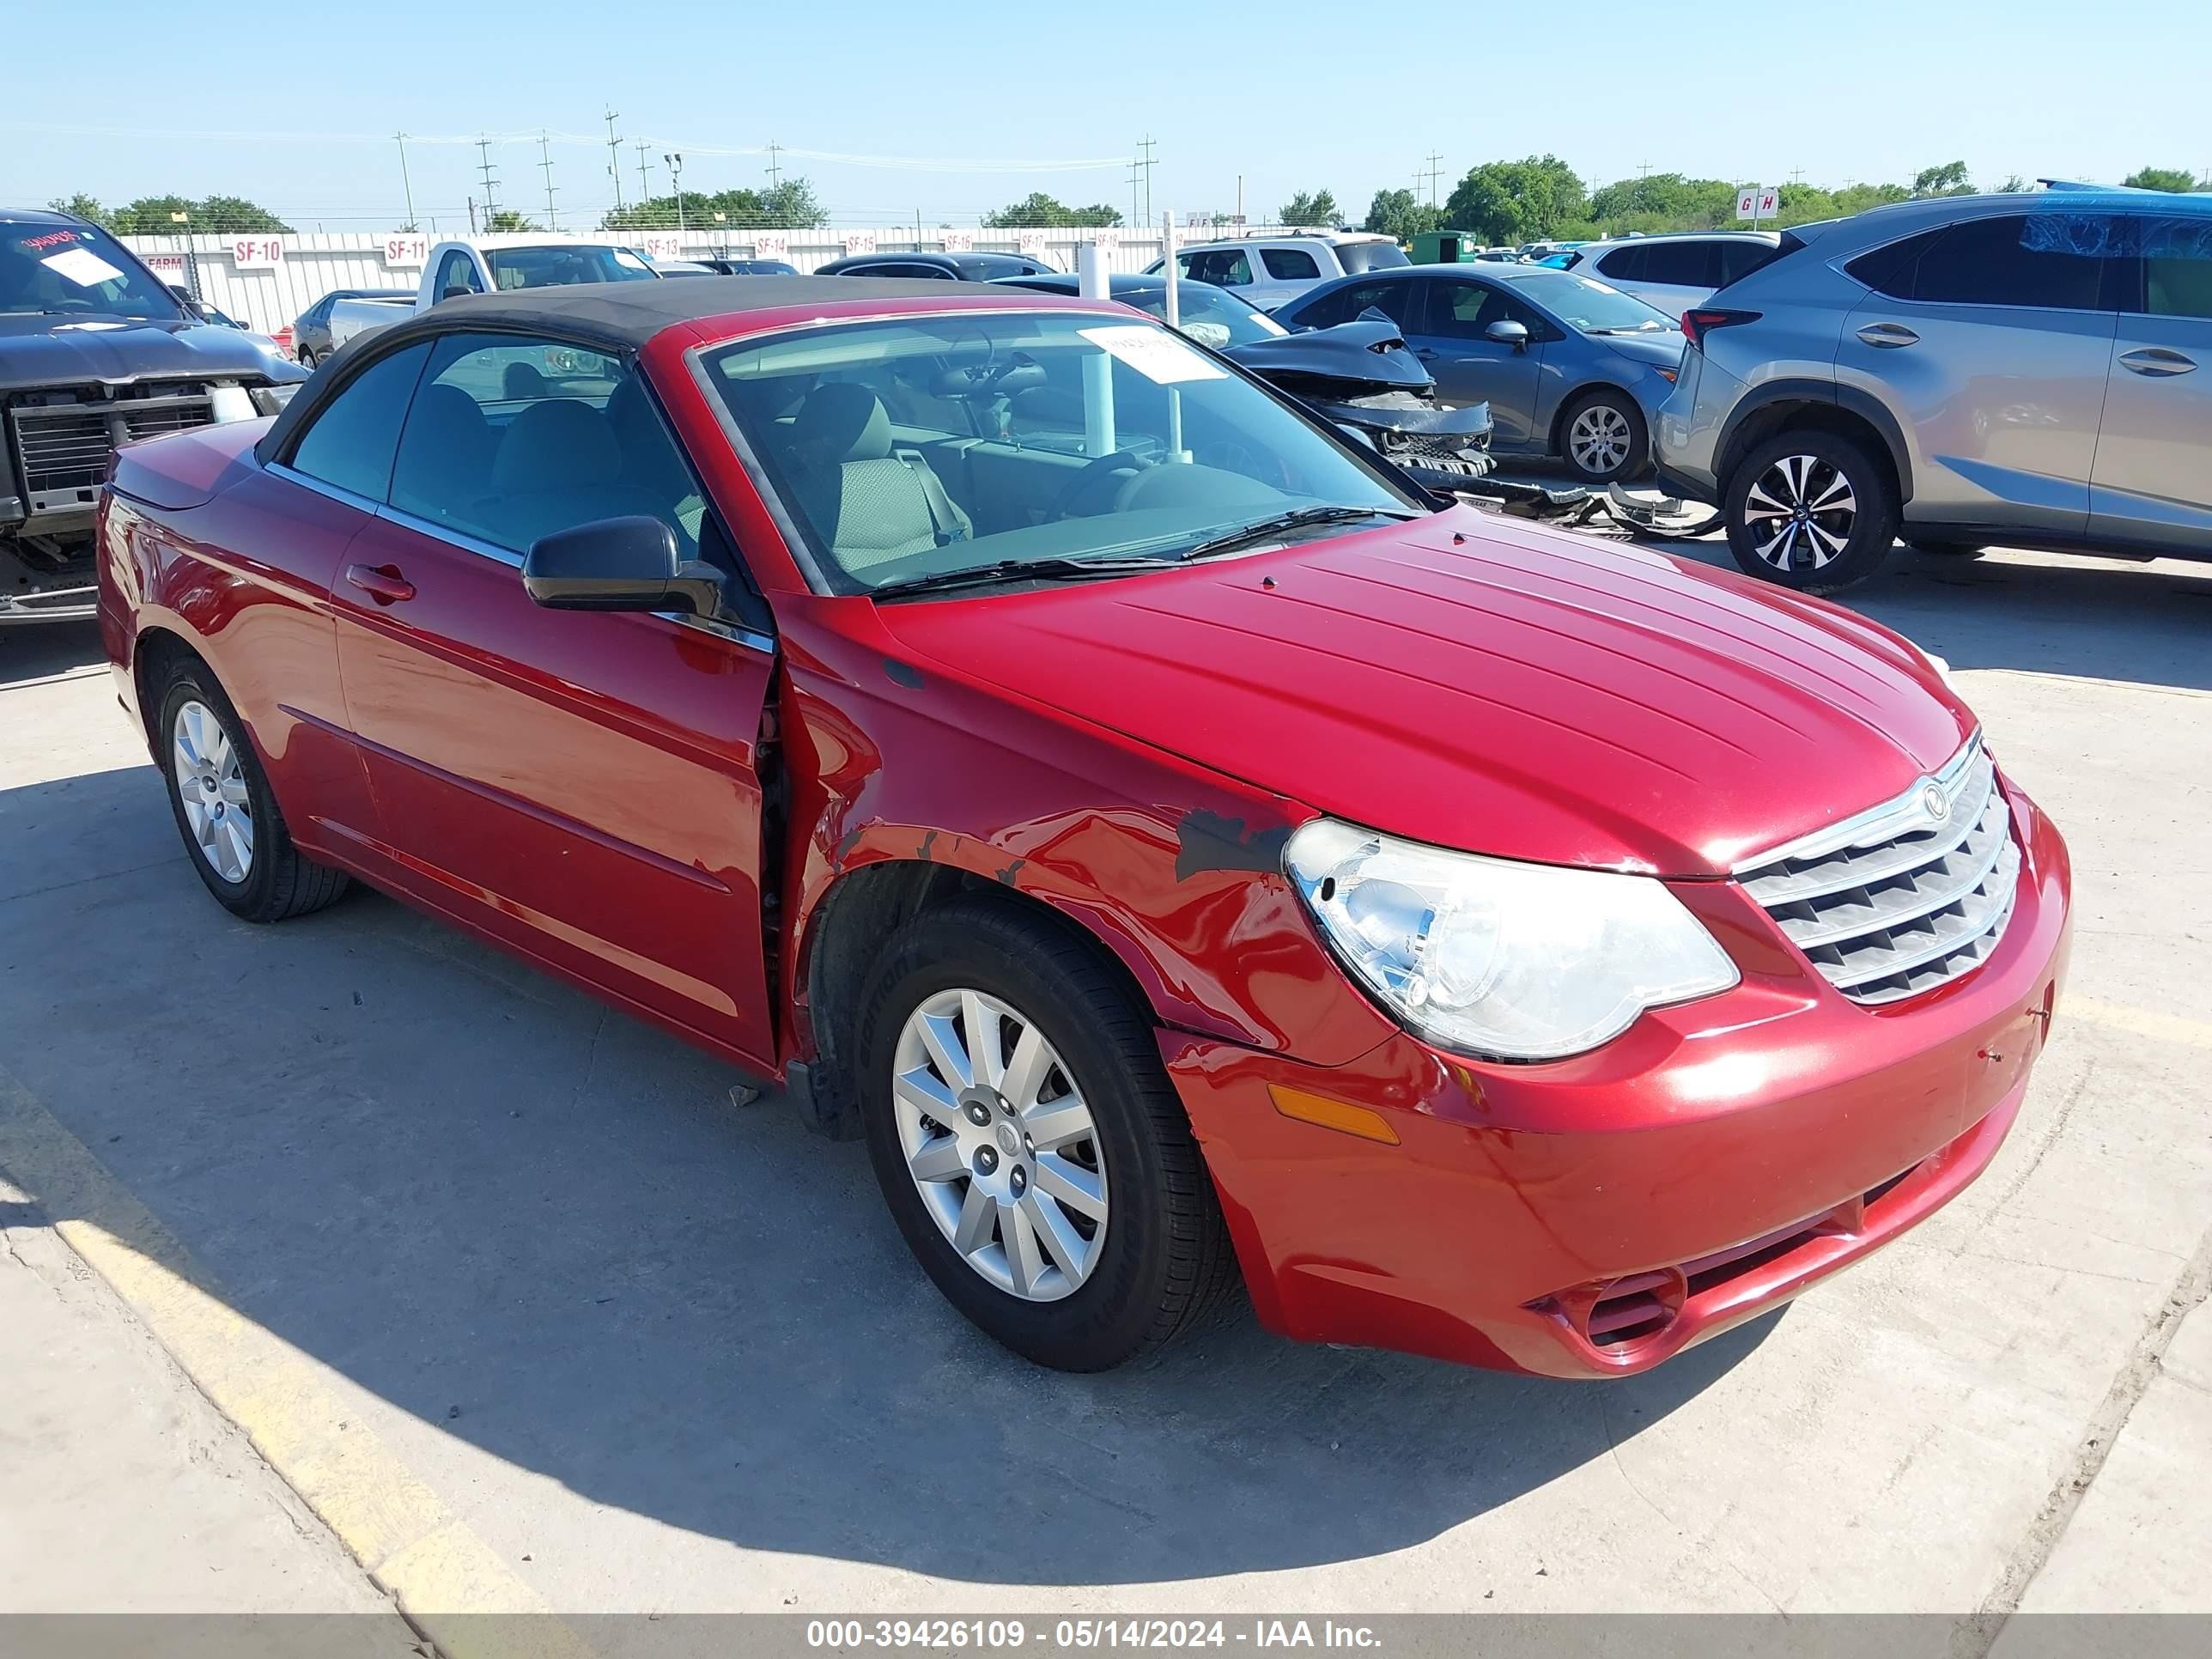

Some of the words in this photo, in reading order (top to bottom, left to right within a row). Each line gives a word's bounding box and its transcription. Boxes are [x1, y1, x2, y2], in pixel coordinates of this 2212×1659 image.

[1741, 198, 1752, 211] G
[1762, 196, 1773, 210] H
[647, 239, 678, 255] SF-13
[757, 237, 786, 254] SF-14
[848, 236, 874, 252] SF-15
[946, 234, 970, 251] SF-16
[1021, 234, 1043, 249] SF-17
[1097, 234, 1117, 248] SF-18
[235, 241, 281, 262] SF-10
[388, 240, 425, 260] SF-11
[148, 258, 183, 270] FARM
[1468, 499, 1487, 507] TEXAS
